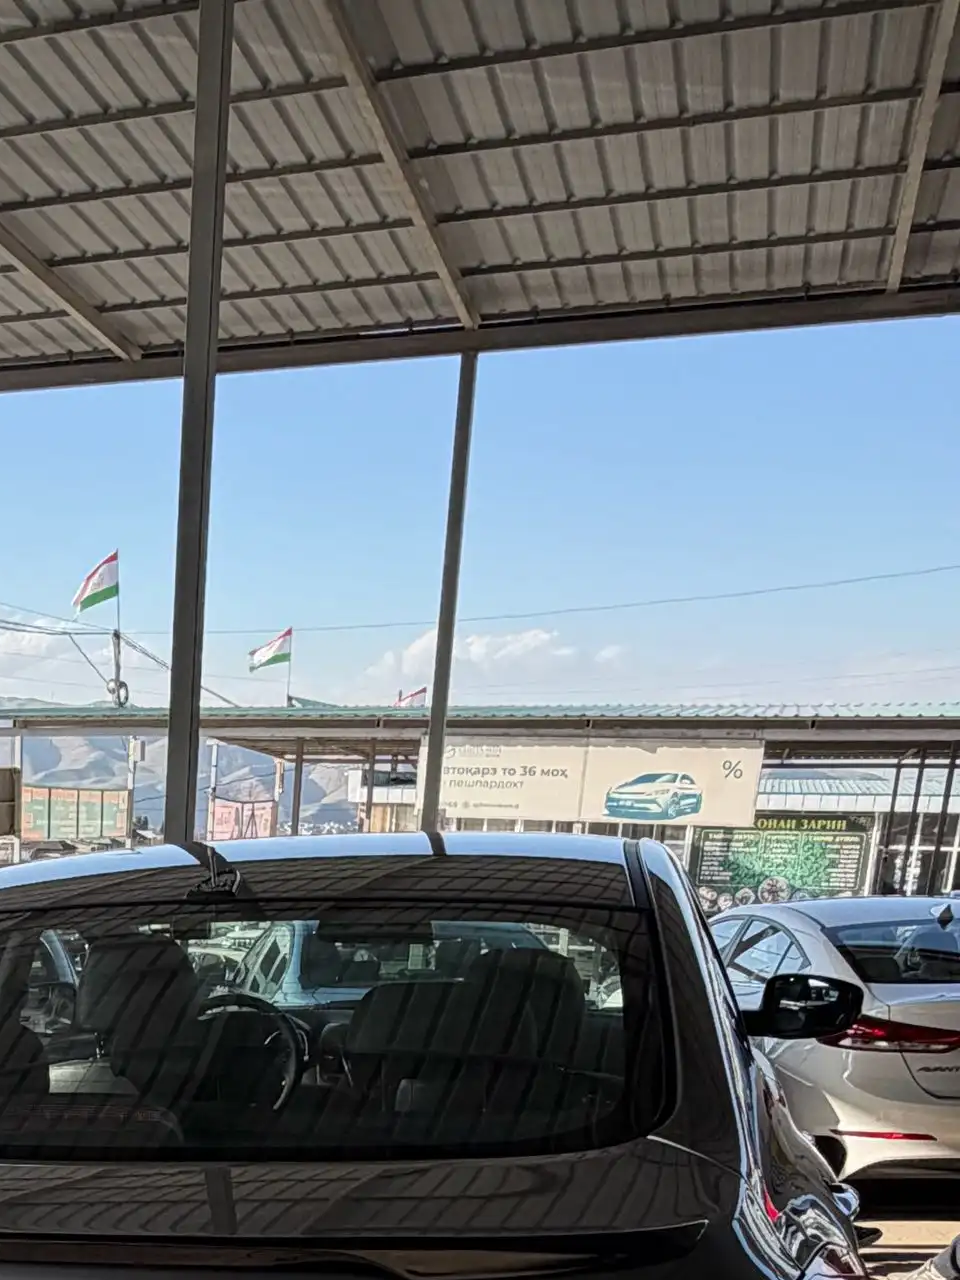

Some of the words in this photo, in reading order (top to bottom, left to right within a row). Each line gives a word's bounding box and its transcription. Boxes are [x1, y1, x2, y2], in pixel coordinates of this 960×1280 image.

[443, 766, 497, 777] втоқарз
[502, 767, 516, 776] то
[520, 766, 536, 777] 36
